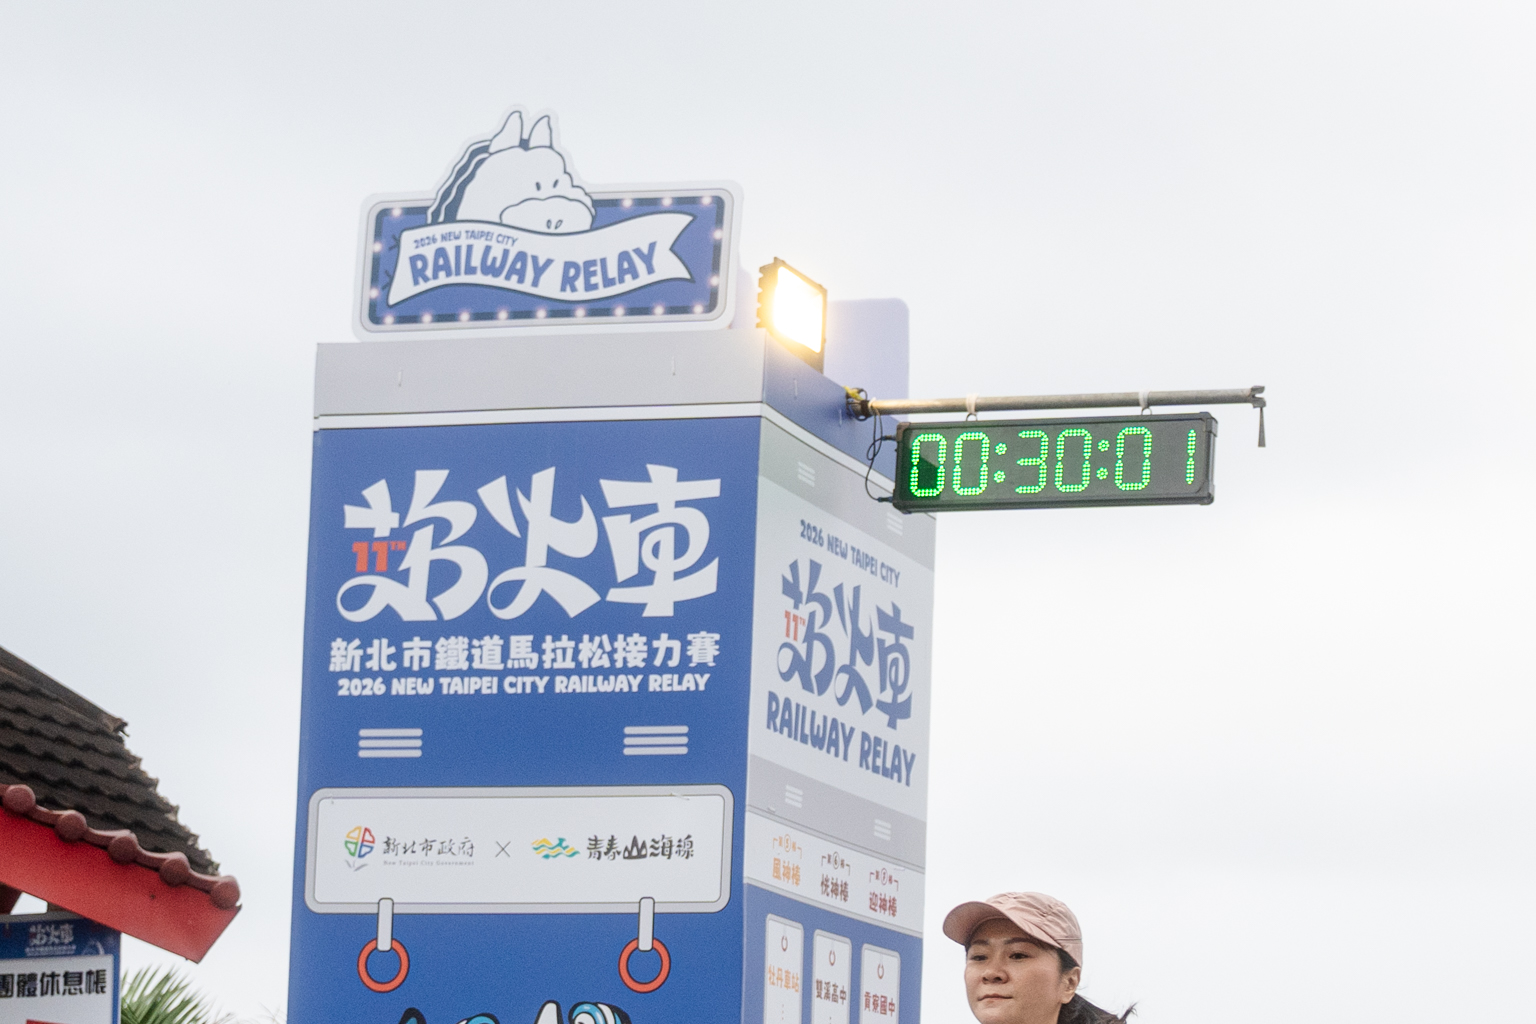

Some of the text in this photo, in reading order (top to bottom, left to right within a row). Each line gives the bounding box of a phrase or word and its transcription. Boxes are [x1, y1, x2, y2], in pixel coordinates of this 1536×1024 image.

[413, 229, 518, 249] 2026 NEW TAIPEI CITY
[409, 241, 658, 293] RAILWAY RELAY
[352, 541, 406, 573] 11TH
[799, 518, 901, 588] 2026 NEW TAIPEI CITY
[328, 630, 721, 673] 新北市鐵道馬拉松接力賽
[337, 673, 711, 696] 2026 NEW TAIPEI CITY RAILWAY RELAY
[766, 690, 916, 787] RAILWAY RELAY
[382, 835, 475, 859] 新北市政府
